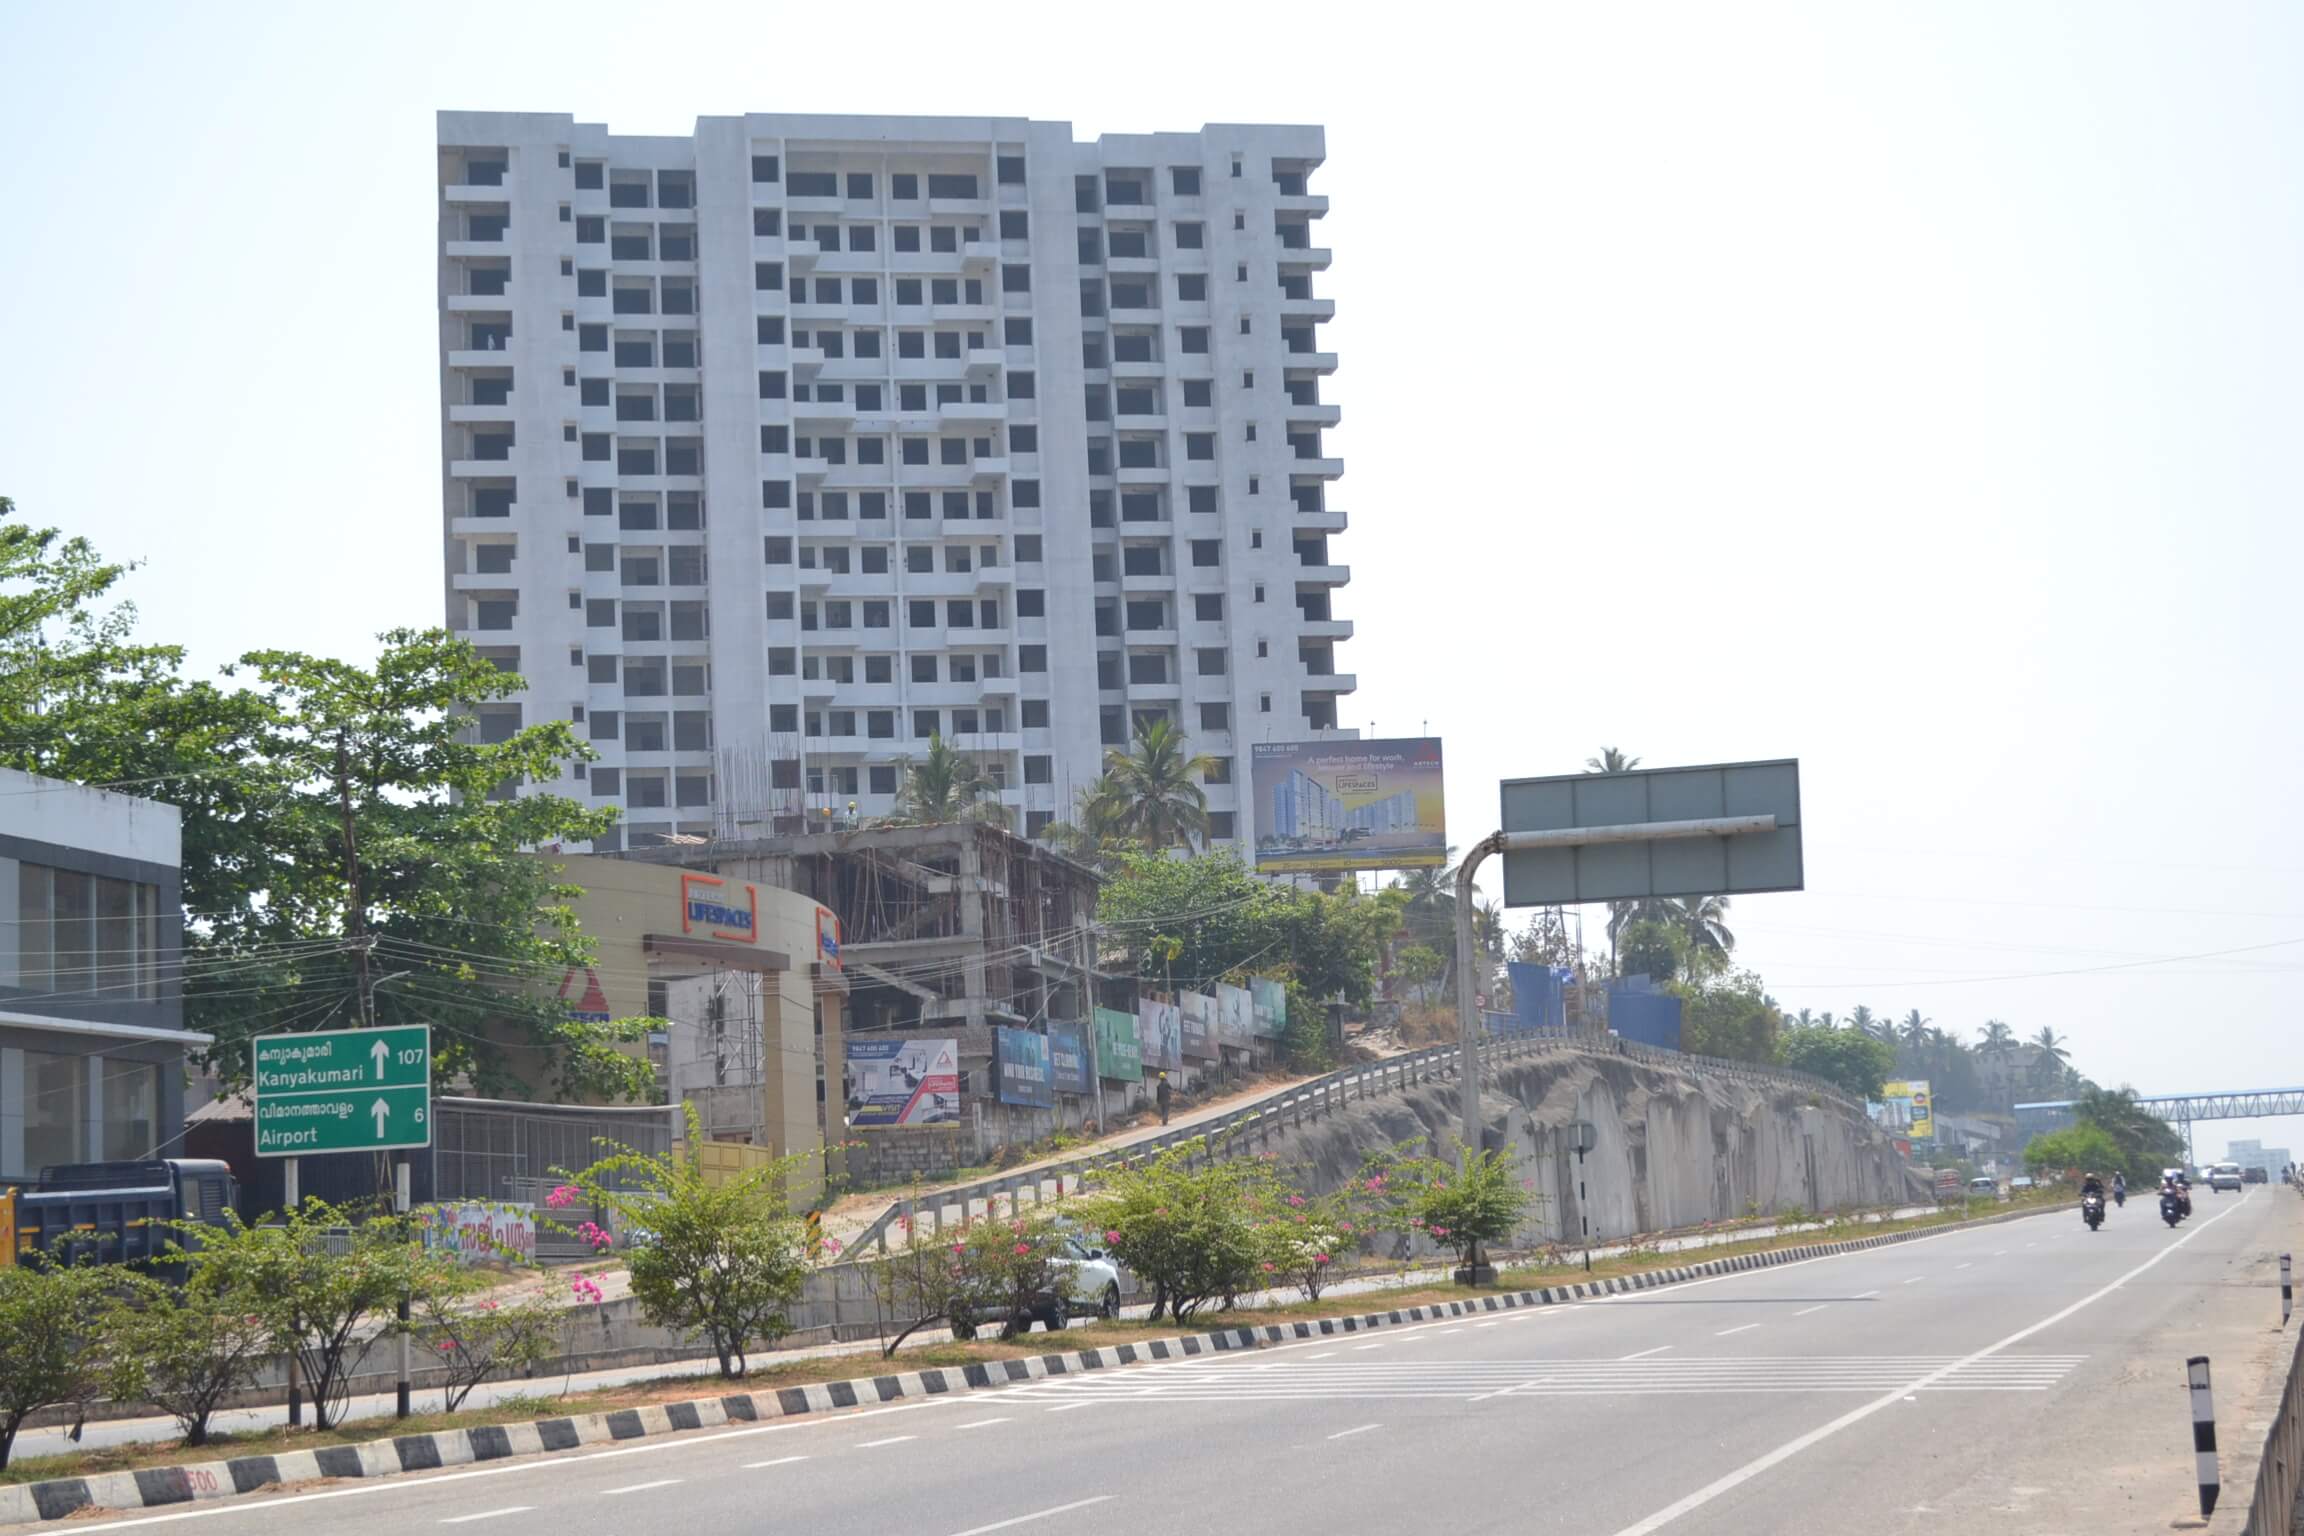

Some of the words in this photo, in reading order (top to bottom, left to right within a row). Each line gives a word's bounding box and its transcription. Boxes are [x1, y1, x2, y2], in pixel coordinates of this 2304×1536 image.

[1315, 755, 1344, 766] perfect
[1369, 754, 1380, 762] for
[688, 902, 753, 929] LIFESPACES
[259, 1041, 332, 1065] കന്യാകുമാരി
[398, 1049, 423, 1065] 107
[259, 1065, 363, 1088] Kanyakumari
[260, 1102, 354, 1119] വിമാനത്താവളം
[414, 1108, 424, 1123] 6
[260, 1127, 317, 1147] Airport
